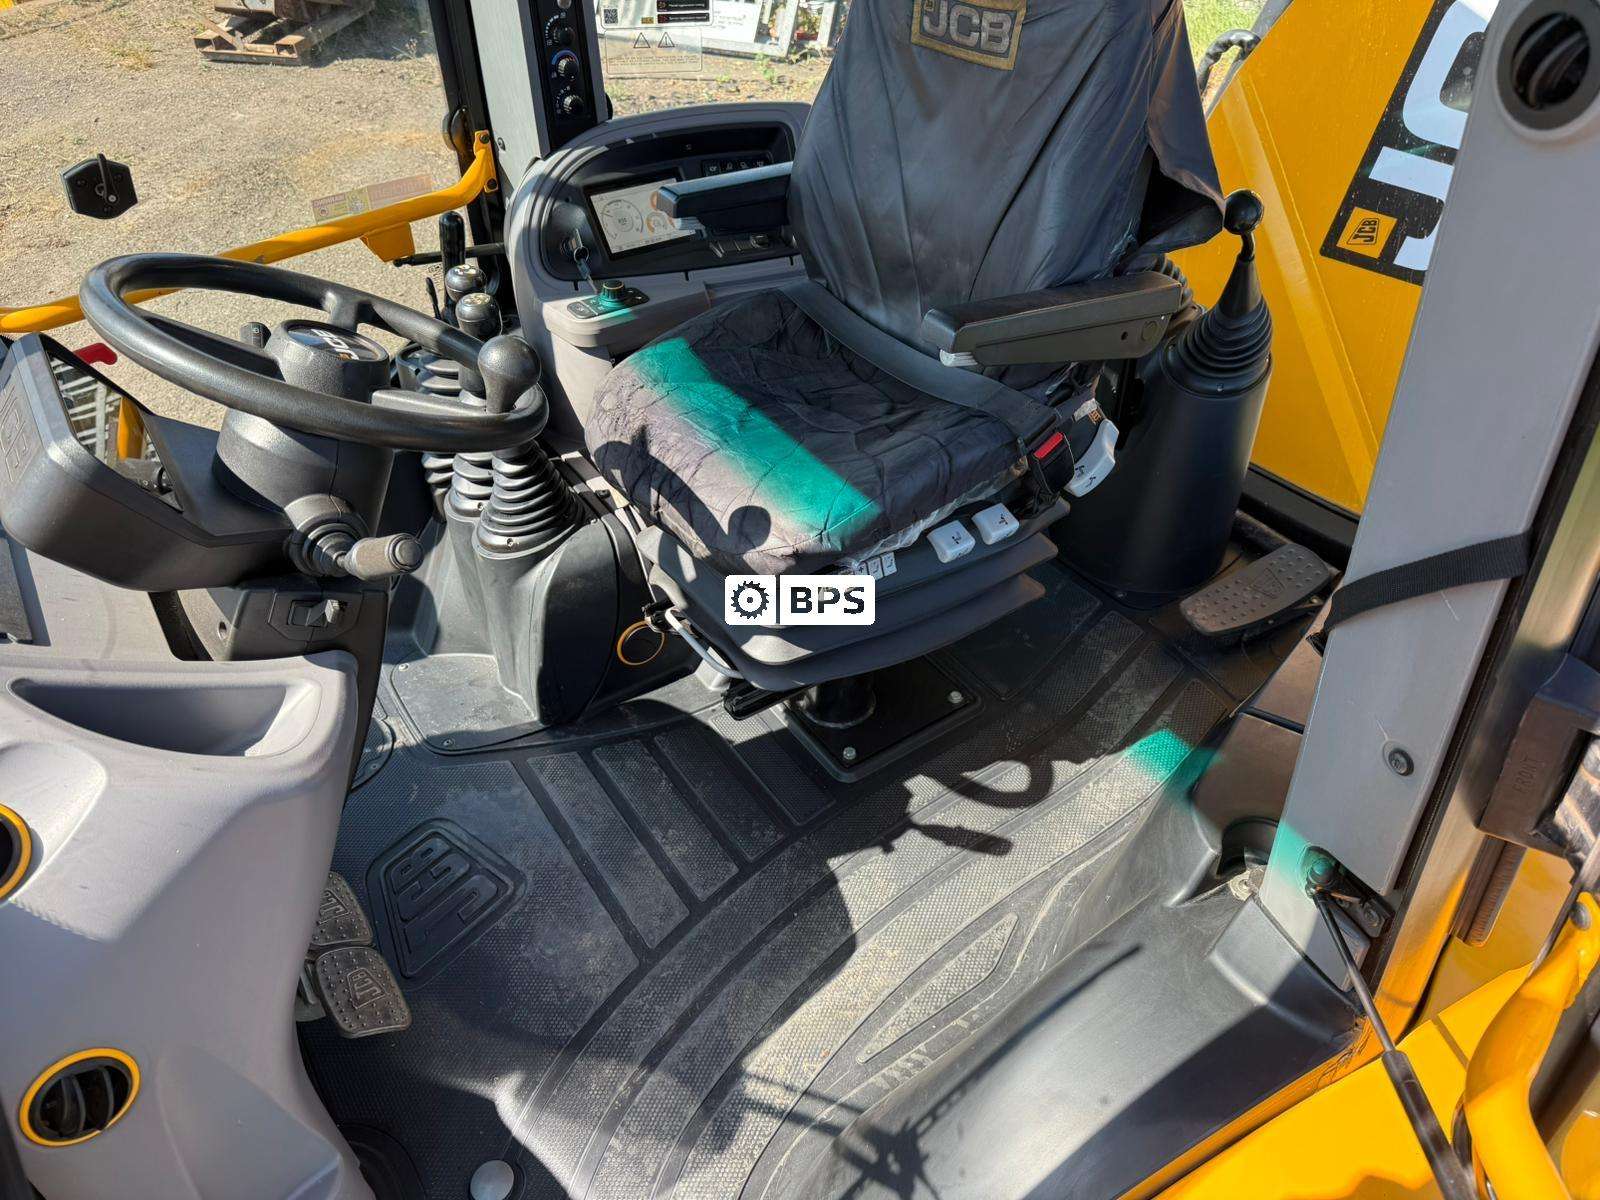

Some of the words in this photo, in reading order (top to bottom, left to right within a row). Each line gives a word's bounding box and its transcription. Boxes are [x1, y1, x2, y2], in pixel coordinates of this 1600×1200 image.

[922, 0, 1012, 54] JCB
[1352, 219, 1378, 243] JCB
[311, 328, 360, 360] JCB
[1511, 752, 1537, 793] FRONT
[390, 836, 499, 954] JCB
[351, 971, 383, 1001] JCB
